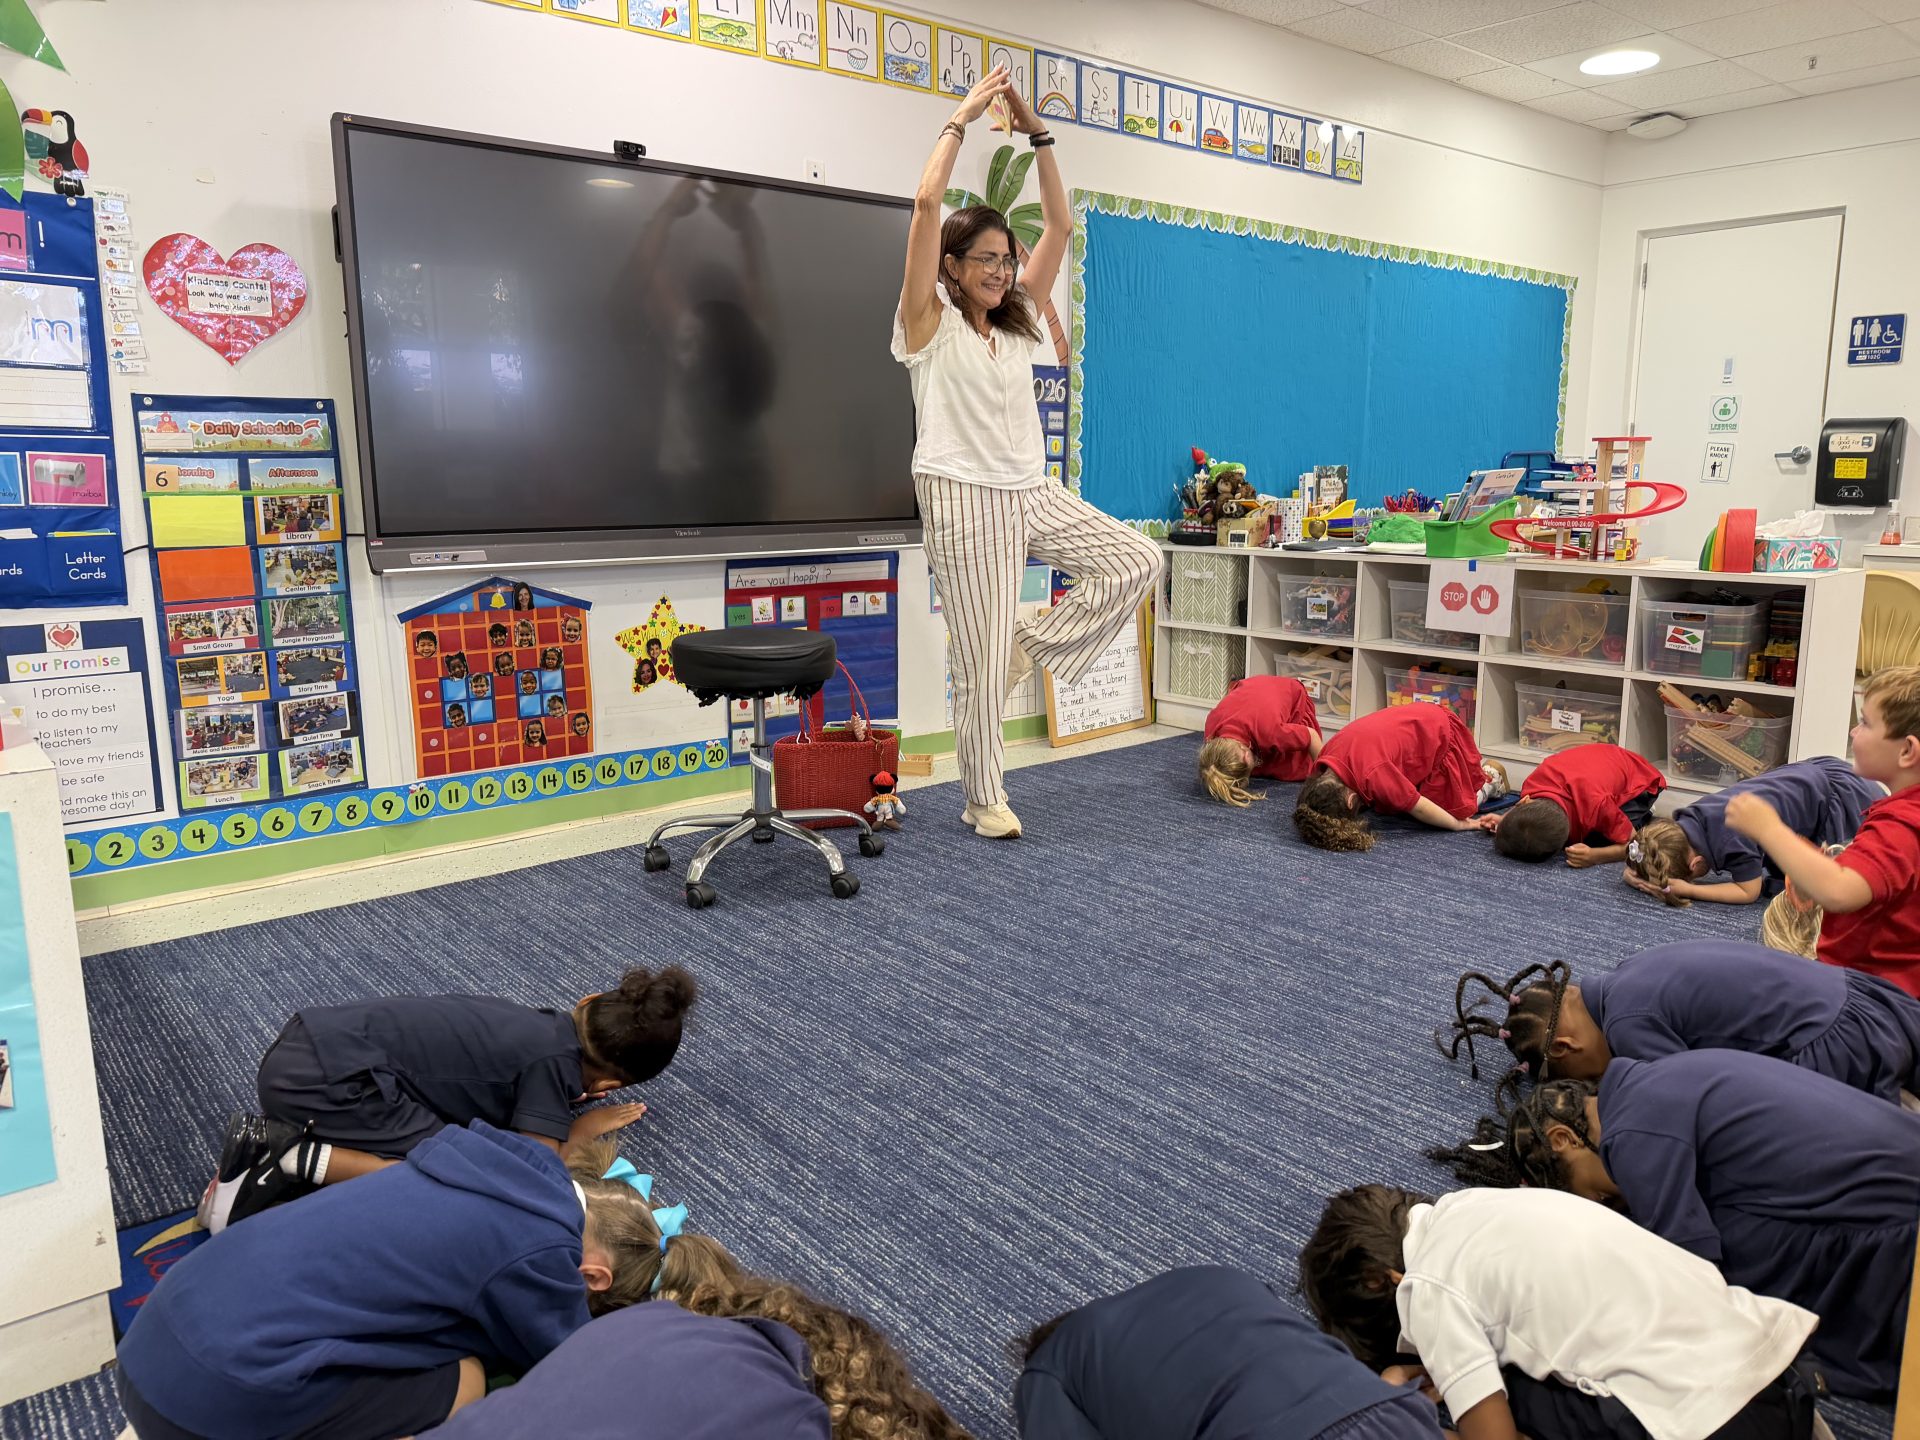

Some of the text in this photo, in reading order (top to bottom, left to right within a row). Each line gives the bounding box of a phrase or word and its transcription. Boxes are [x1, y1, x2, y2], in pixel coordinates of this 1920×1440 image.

[769, 0, 814, 32] Mm
[837, 6, 868, 45] Nn
[888, 20, 927, 58] Oo
[951, 34, 973, 84] Pp
[1047, 59, 1067, 92] Rr
[1091, 70, 1109, 102] Ss
[1132, 80, 1151, 112] Tt
[1169, 90, 1192, 121] Uu
[1208, 100, 1228, 129] Vv
[1241, 108, 1265, 138] Ww
[1278, 117, 1296, 145] Xx
[188, 276, 267, 291] Kindness Counts!
[209, 303, 229, 311] being
[31, 317, 73, 343] m
[204, 422, 303, 437] Daily Schedule
[155, 471, 168, 487] 6
[269, 468, 318, 478] Afternoon
[286, 532, 312, 540] Library
[65, 552, 106, 564] Letter
[0, 563, 23, 575] rds
[68, 568, 107, 580] Cards
[735, 574, 756, 587] Are
[767, 577, 785, 587] you
[793, 572, 819, 585] happy
[1443, 592, 1465, 601] STOP
[734, 612, 746, 622] yes
[282, 634, 335, 644] Jungle Playground
[621, 632, 635, 643] We
[193, 641, 233, 650] Small Group
[15, 655, 121, 674] Our Promise
[1113, 659, 1125, 669] and
[33, 682, 117, 700] I promise...
[298, 685, 313, 693] Story
[1059, 674, 1127, 697] going to the Library
[217, 694, 235, 702] Yoga
[1060, 699, 1067, 708] to
[1070, 694, 1084, 706] meet
[36, 703, 117, 719] to do my best
[1063, 711, 1076, 722] Lots
[39, 723, 119, 740] to listen to my
[40, 735, 92, 749] teachers
[59, 757, 84, 767] love
[87, 754, 105, 766] my
[108, 749, 145, 761] friends
[61, 773, 105, 786] be safe
[307, 781, 326, 789] Snack
[75, 793, 108, 805] make
[111, 790, 130, 801] this
[132, 789, 147, 797] an
[109, 841, 123, 858] 2
[152, 835, 164, 852] 3
[192, 828, 205, 844] 4
[234, 821, 245, 838] 5
[272, 815, 284, 831] 6
[311, 809, 324, 826] 7
[347, 804, 357, 820] 8
[382, 799, 393, 814] 9
[414, 793, 430, 809] 10
[448, 788, 460, 804] 11
[479, 783, 495, 799] 12
[512, 778, 527, 794] 13
[542, 773, 558, 788] 14
[571, 769, 587, 784] 15
[602, 765, 616, 779] 16
[630, 760, 644, 775] 17
[657, 756, 670, 770] 18
[684, 752, 698, 767] 19
[708, 748, 724, 763] 20
[110, 799, 135, 812] day!
